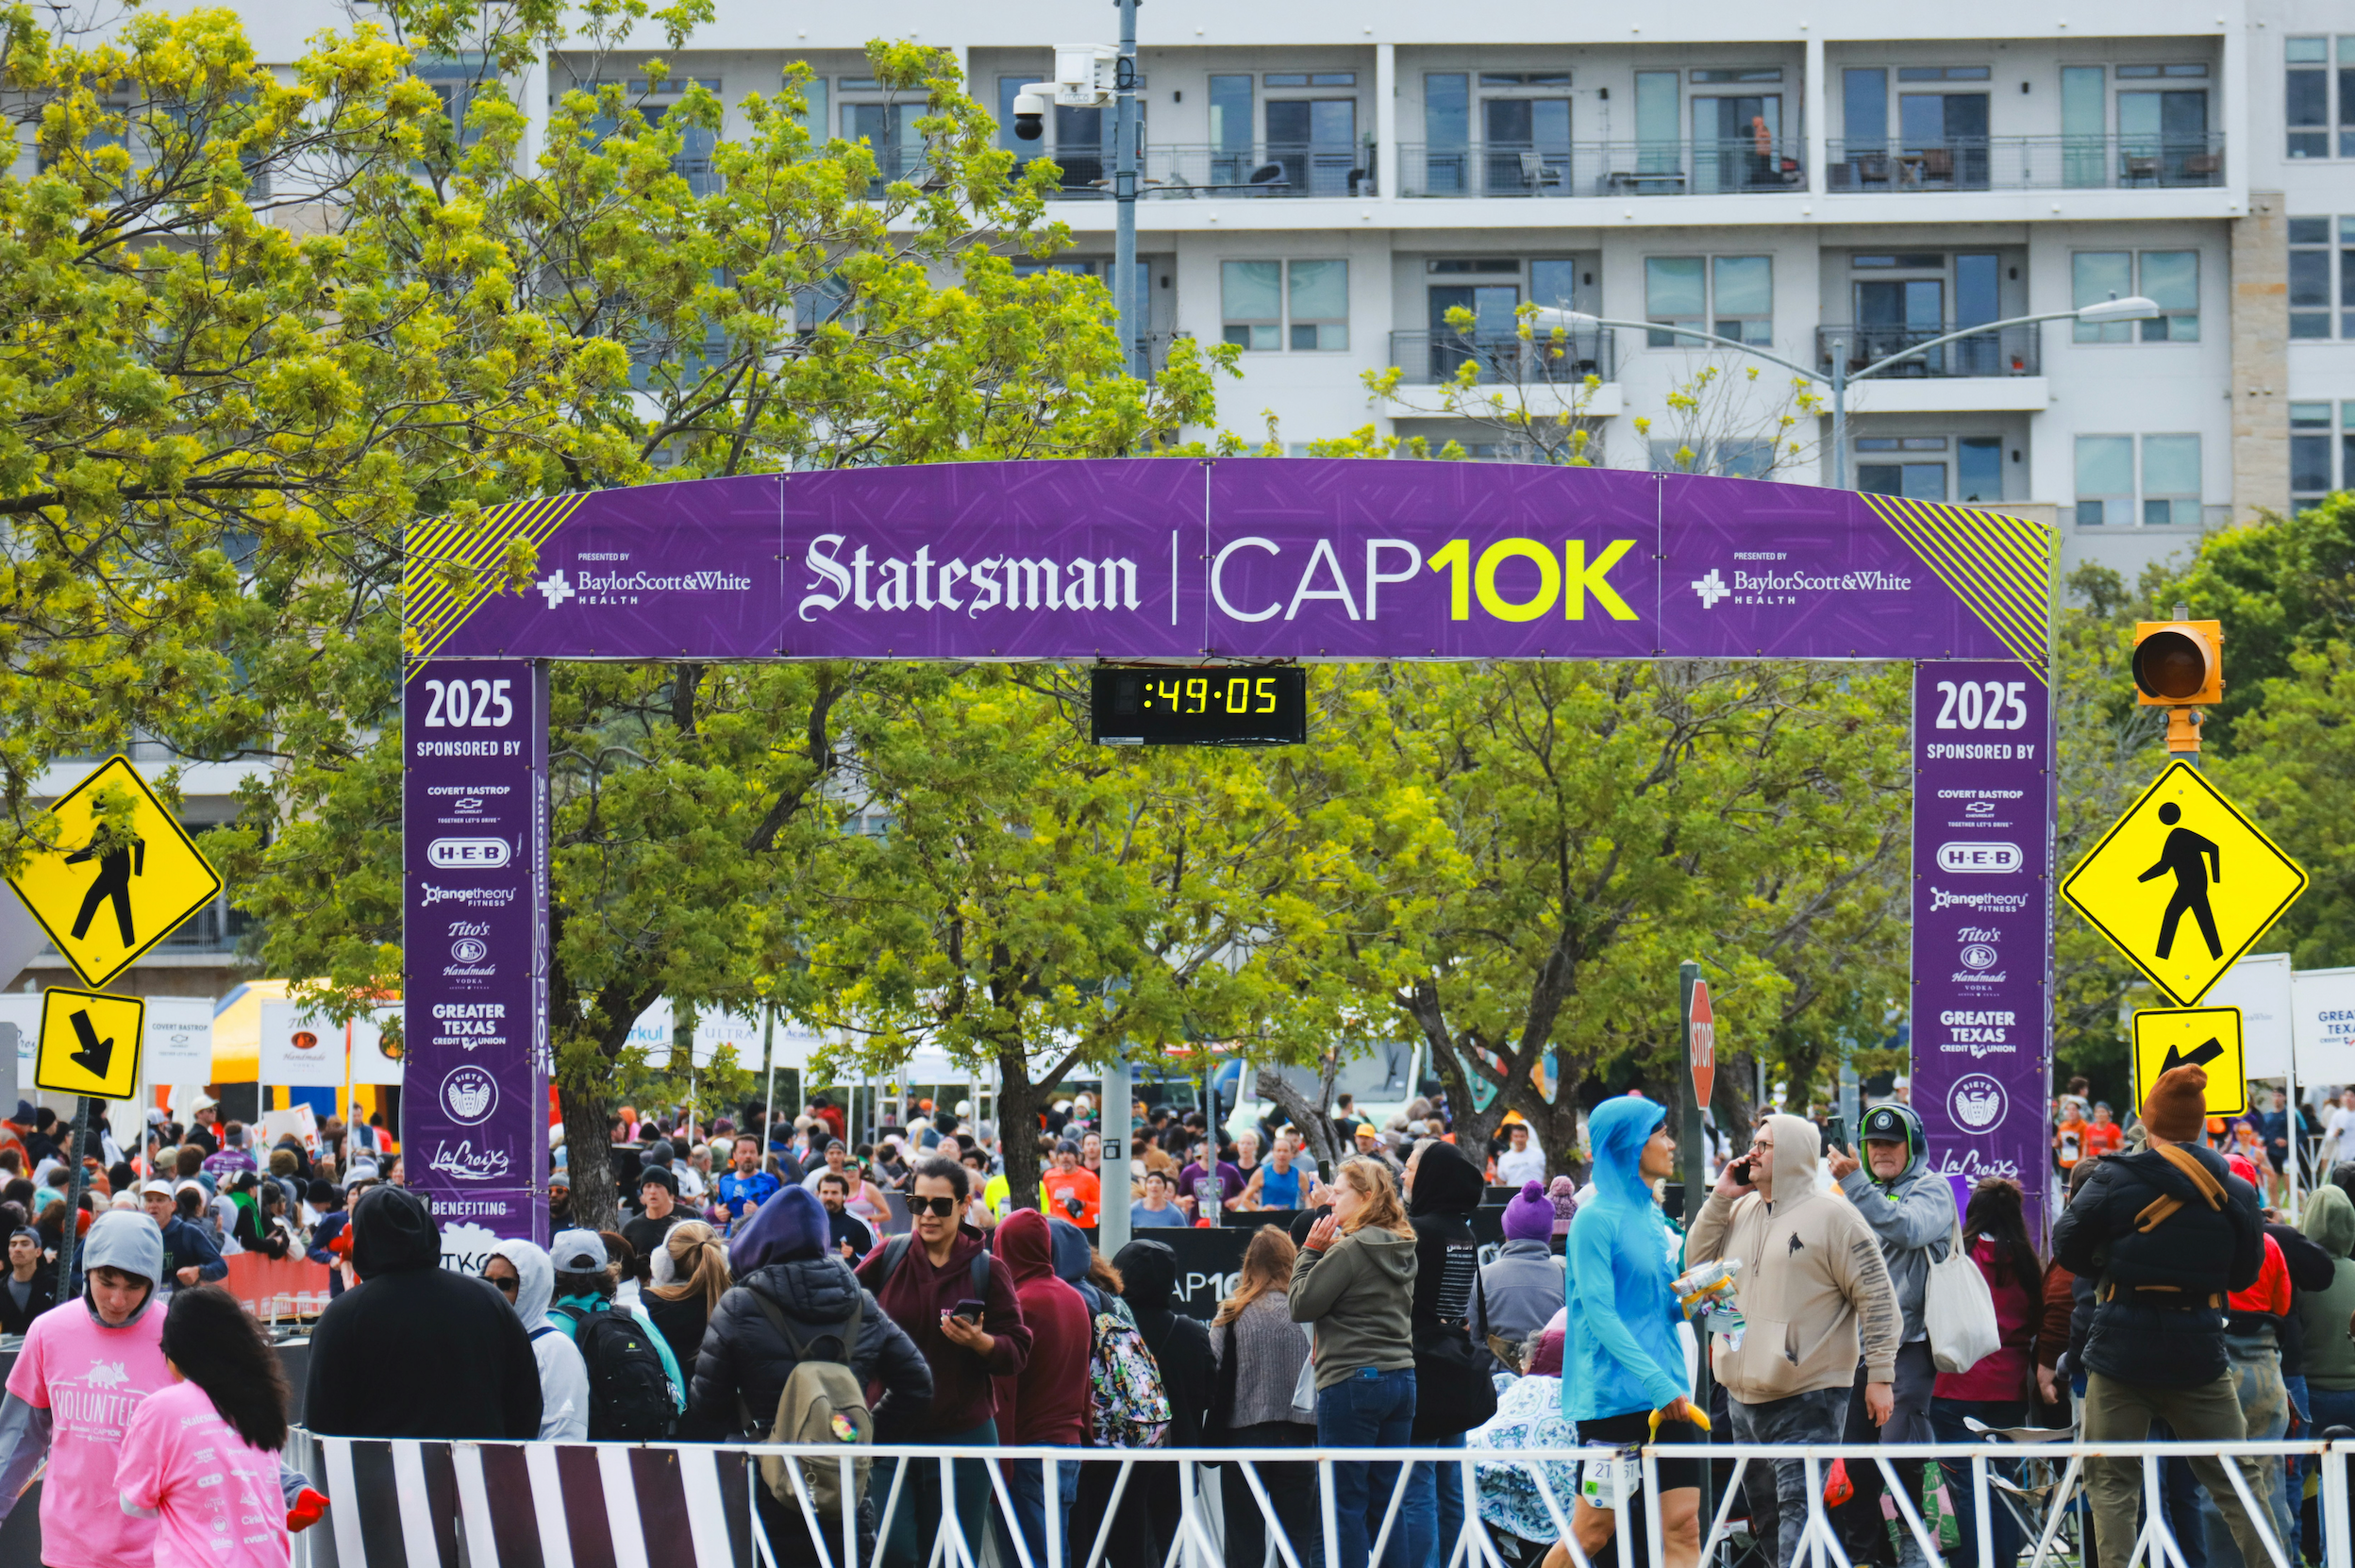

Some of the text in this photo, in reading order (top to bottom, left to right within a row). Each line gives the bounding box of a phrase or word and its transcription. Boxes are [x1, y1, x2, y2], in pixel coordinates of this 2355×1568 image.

[577, 553, 619, 561] PRESENTED
[1734, 552, 1787, 560] PRESENTED BY
[798, 534, 1143, 623] Statesman
[1211, 535, 1640, 623] CAP10K
[578, 596, 638, 605] HEALTH
[1734, 596, 1795, 605] HEALTH
[425, 679, 513, 727] 2025
[1936, 681, 2028, 730] 2025
[417, 741, 521, 757] SPONSORED BY
[1927, 743, 2035, 759] SPONSORED BY
[427, 786, 510, 795] COVERT BASTROP
[1937, 790, 1977, 798] COVERT
[448, 921, 490, 936] Tito's
[1957, 926, 2000, 942] Tito's
[443, 963, 496, 976] Handmade
[1951, 970, 2006, 982] Handmade
[432, 1004, 506, 1019] GREATER
[1940, 1010, 2015, 1026] GREATER
[443, 1021, 495, 1035] TEXAS
[626, 1025, 662, 1041] rkul
[705, 1026, 754, 1041] ULTRA
[1950, 1027, 2005, 1043] TEXAS
[477, 1037, 506, 1045] UNION
[1692, 1022, 1712, 1067] STOP
[1987, 1044, 2016, 1053] UNION
[455, 1074, 482, 1082] SIETE
[1962, 1081, 1993, 1091] SIETE
[432, 1202, 507, 1215] BENEFITING
[56, 1389, 142, 1427] VOLUNTEE
[1586, 1484, 1594, 1493] A
